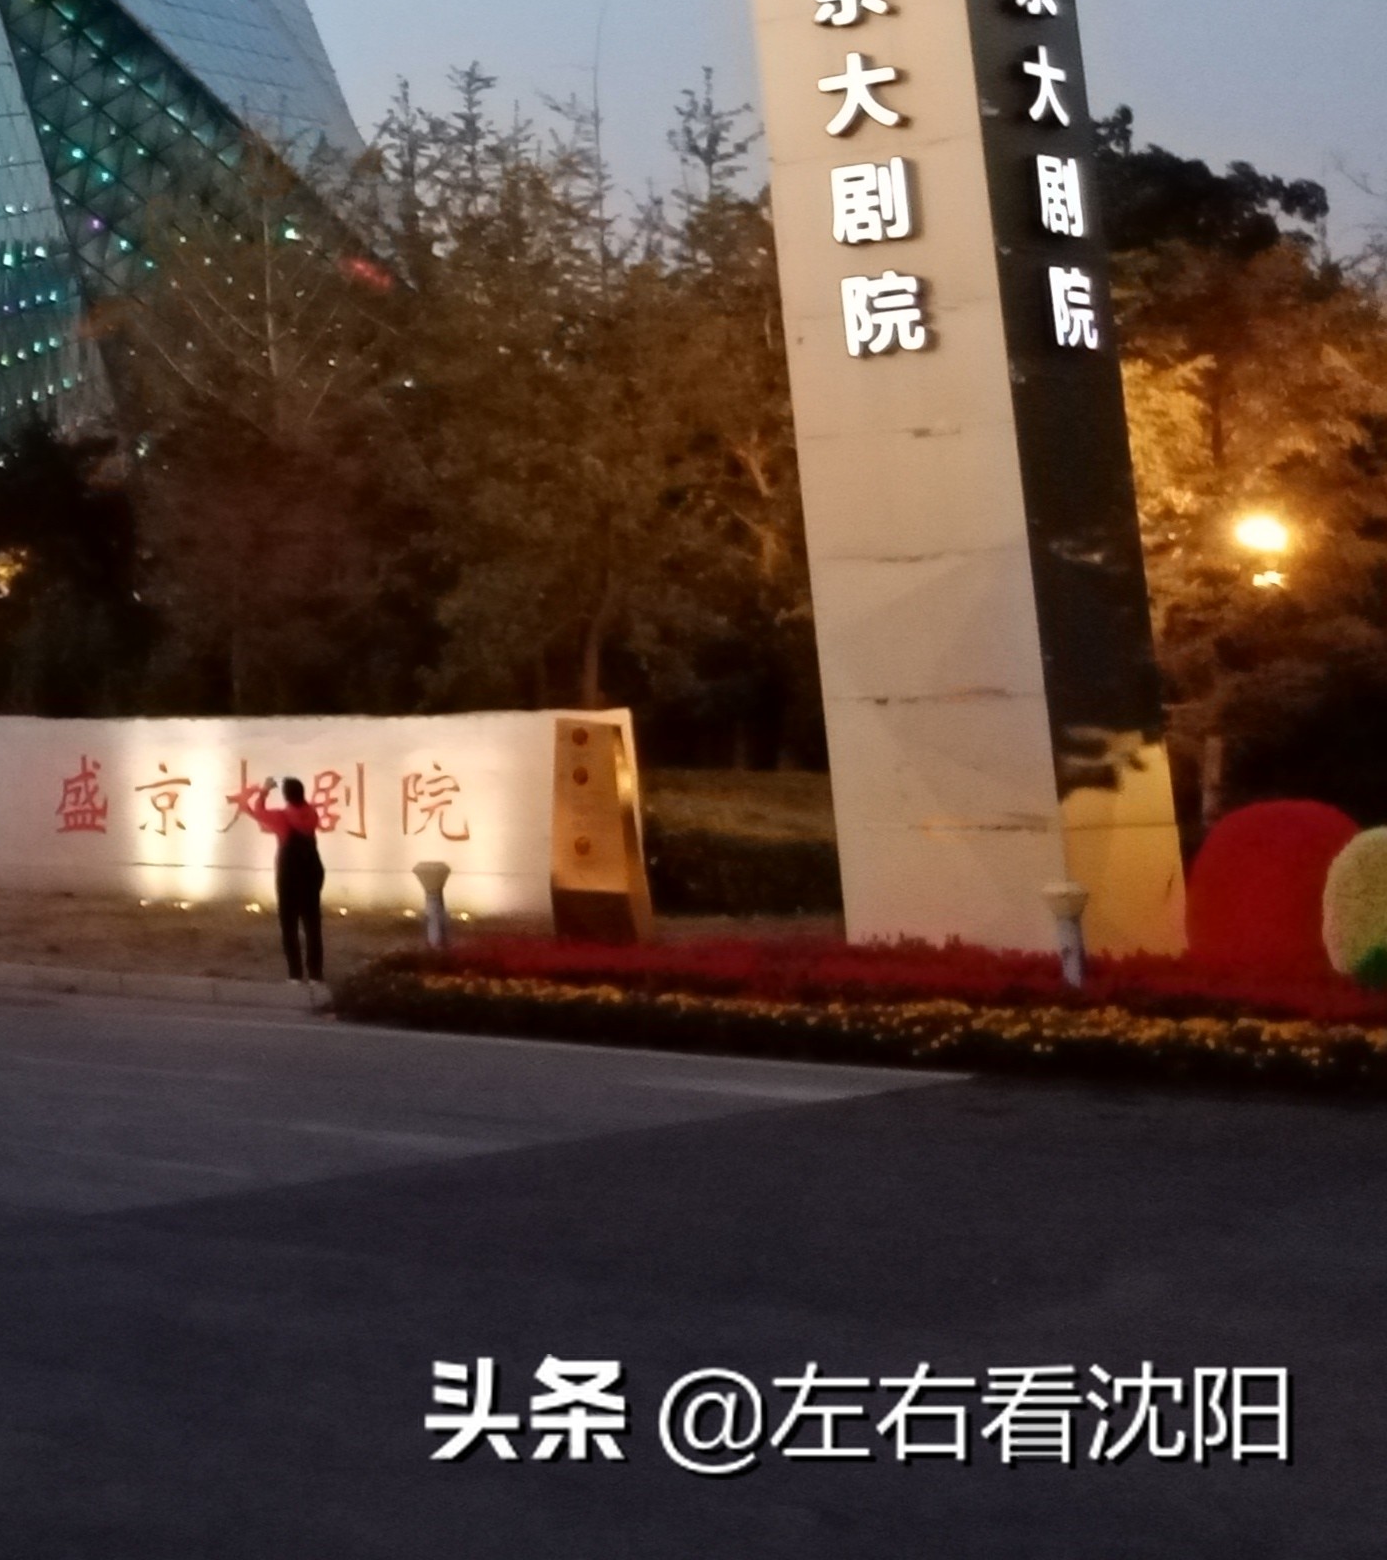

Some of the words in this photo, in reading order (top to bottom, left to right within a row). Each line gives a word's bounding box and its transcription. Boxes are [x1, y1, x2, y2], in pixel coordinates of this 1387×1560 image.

[55, 754, 470, 842] 盛京大剧院
